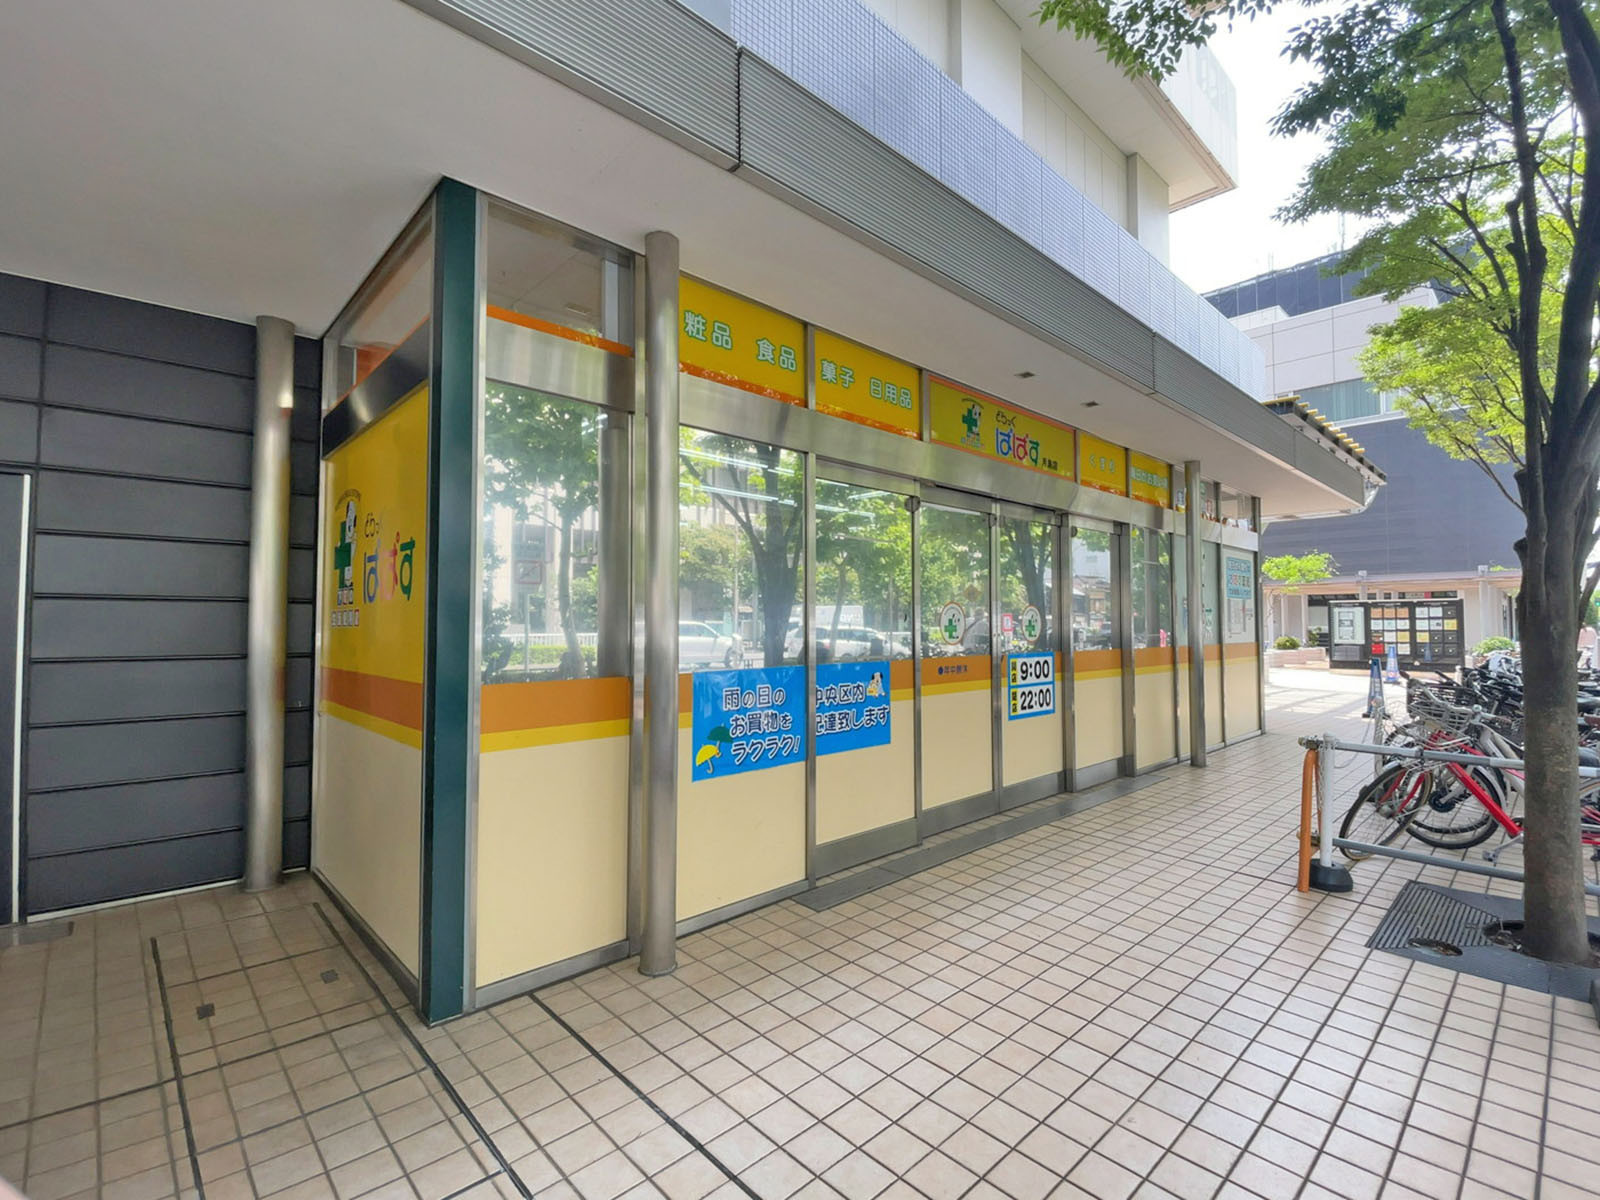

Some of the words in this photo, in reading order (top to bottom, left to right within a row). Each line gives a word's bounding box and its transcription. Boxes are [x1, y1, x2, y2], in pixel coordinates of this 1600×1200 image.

[756, 338, 797, 371] 食品
[821, 359, 855, 388] 菓子
[869, 378, 912, 409] 日用品
[1020, 660, 1050, 680] 9:00
[722, 684, 785, 711] 雨の日の
[1020, 688, 1052, 711] 22:00
[730, 710, 793, 737] お買物を
